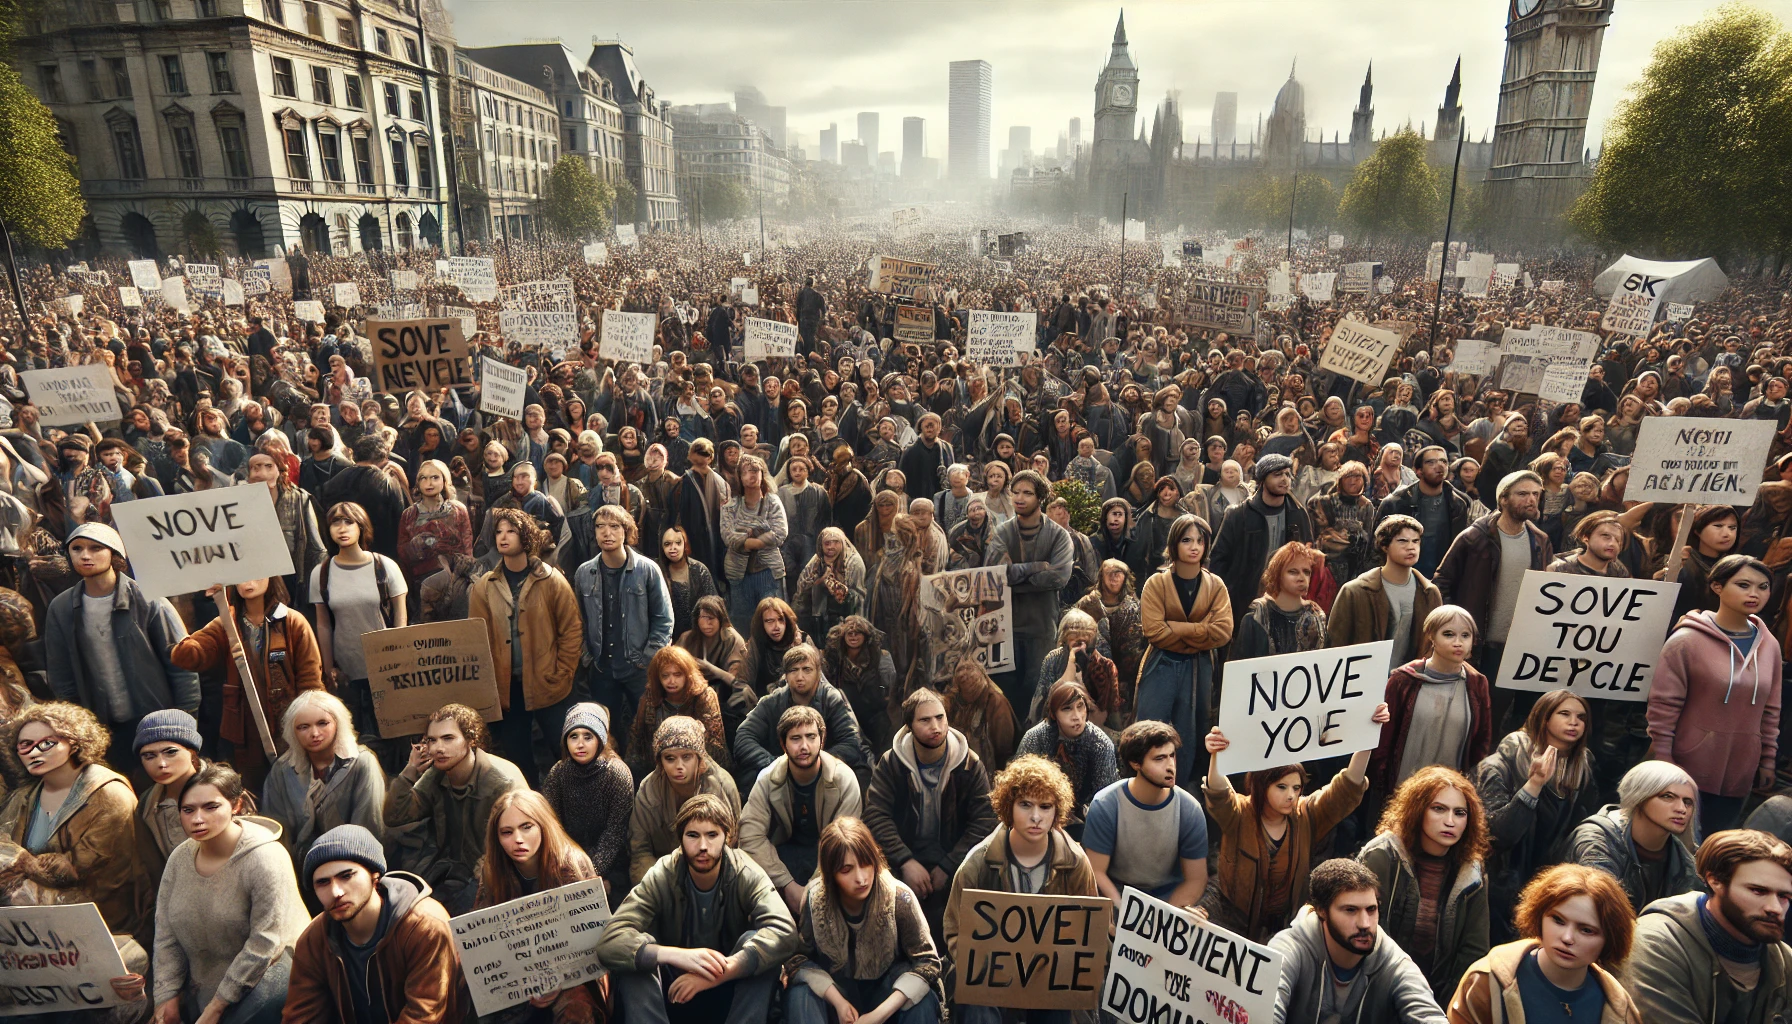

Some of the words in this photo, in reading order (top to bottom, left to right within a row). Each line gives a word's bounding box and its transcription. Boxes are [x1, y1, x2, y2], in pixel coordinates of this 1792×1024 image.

[378, 324, 451, 358] SOVE
[146, 502, 245, 540] NOVE
[1535, 582, 1658, 621] SOVE
[1552, 622, 1623, 654] TOU
[1248, 655, 1373, 716] NOVE
[971, 900, 1103, 947] SOVET
